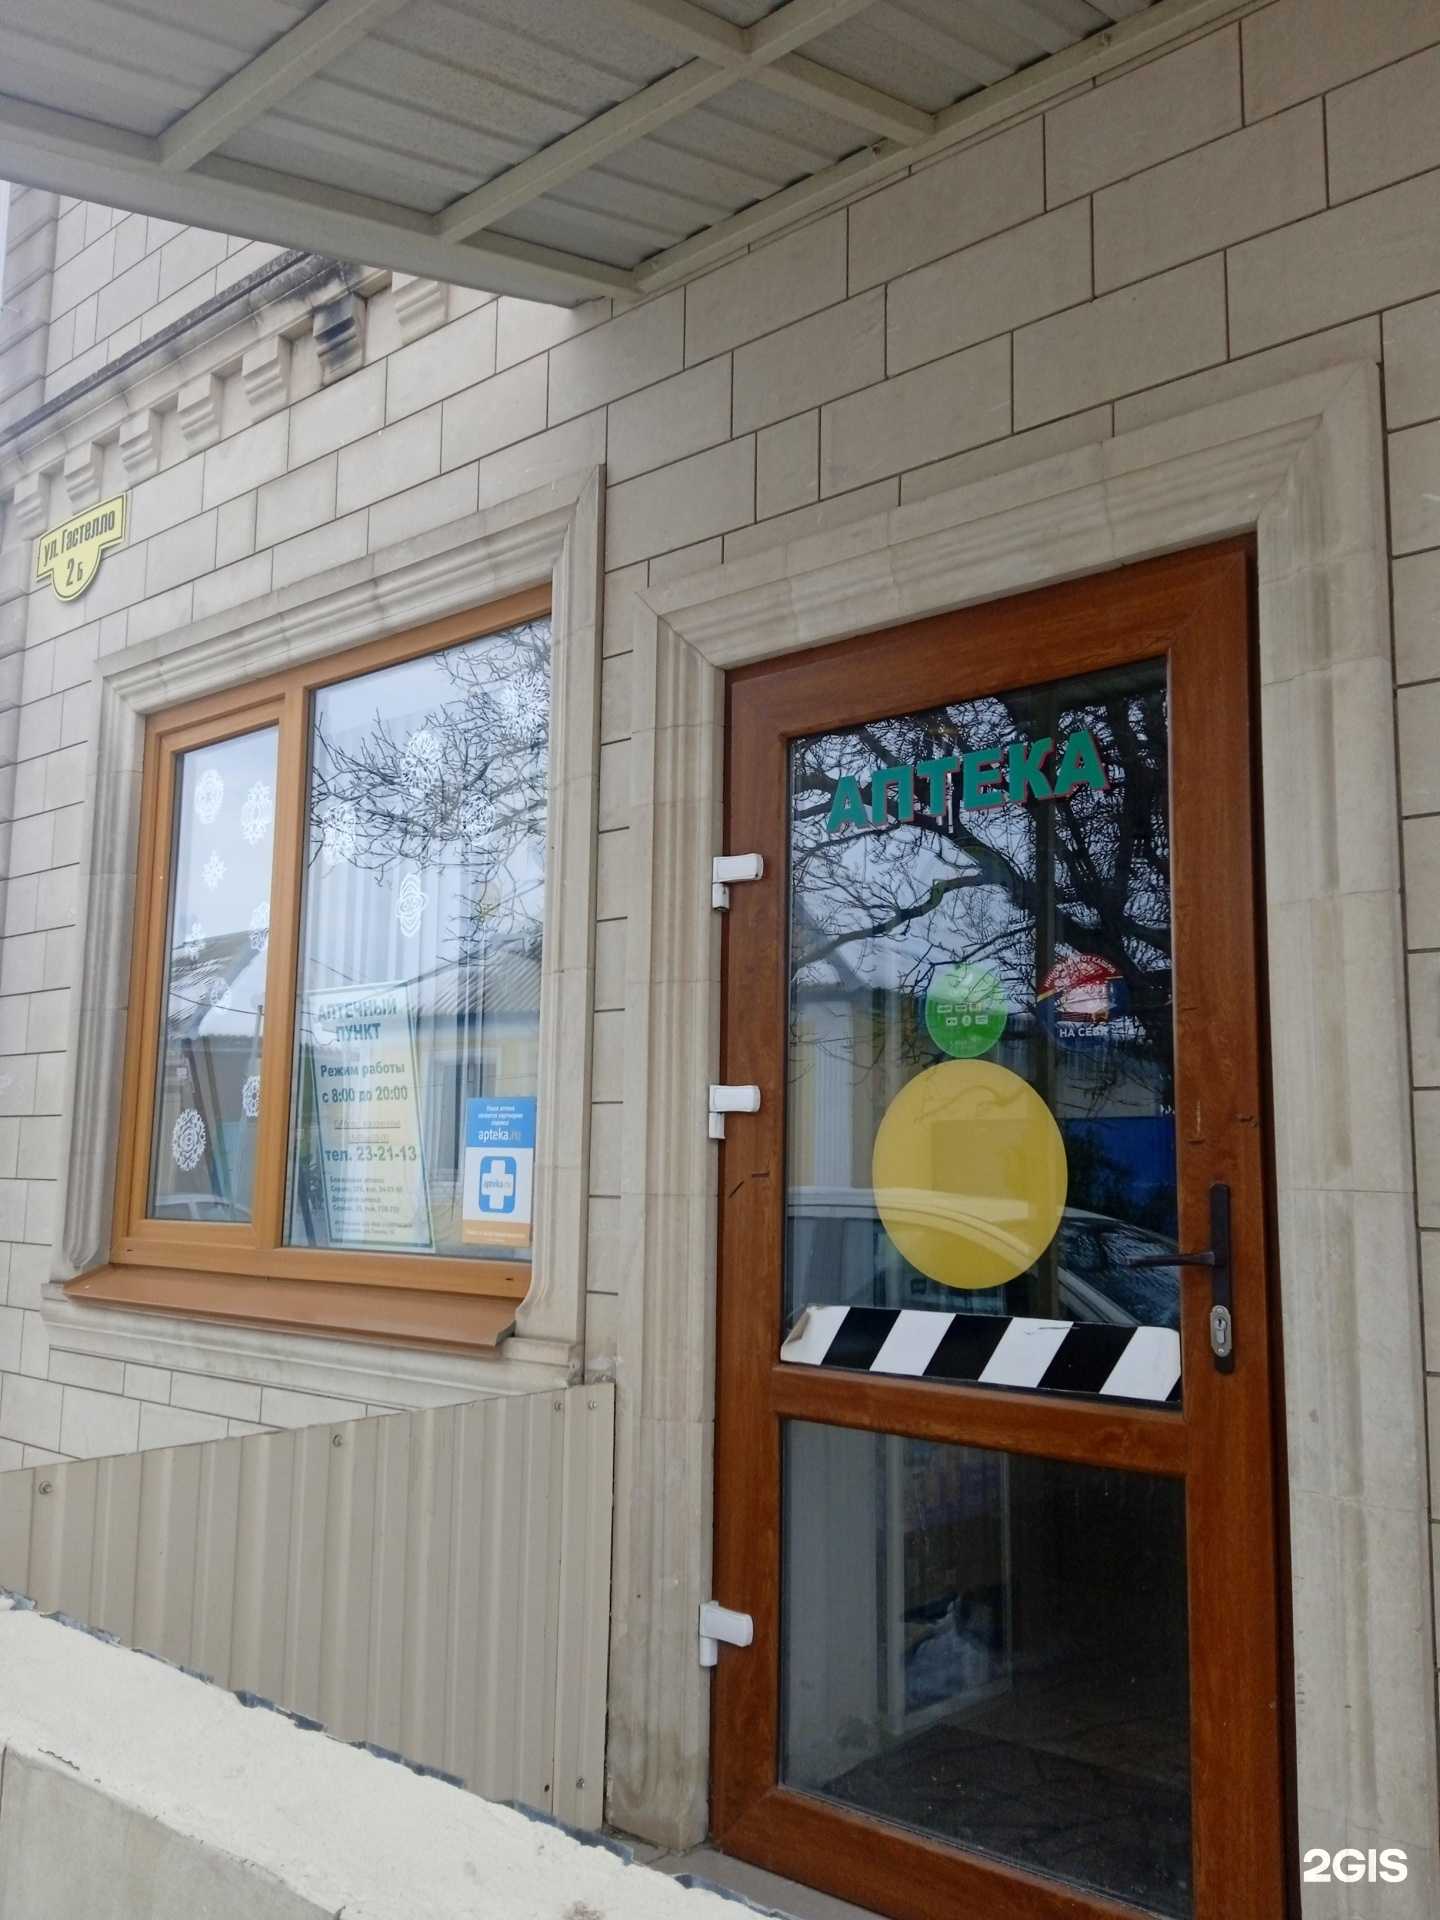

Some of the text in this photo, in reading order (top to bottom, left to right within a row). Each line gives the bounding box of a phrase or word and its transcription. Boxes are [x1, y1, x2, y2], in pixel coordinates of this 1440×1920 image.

[44, 509, 116, 567] ул. Гастелло
[825, 728, 1109, 834] АПТЕКА
[318, 997, 398, 1020] АПТЕЧНЫЙ
[335, 1022, 382, 1042] ПУНКТ
[1059, 1028, 1076, 1038] НА
[320, 1061, 405, 1079] Режим работы
[322, 1086, 409, 1103] с 8:00 до 20:00
[325, 1145, 417, 1162] тел. 23-21-13
